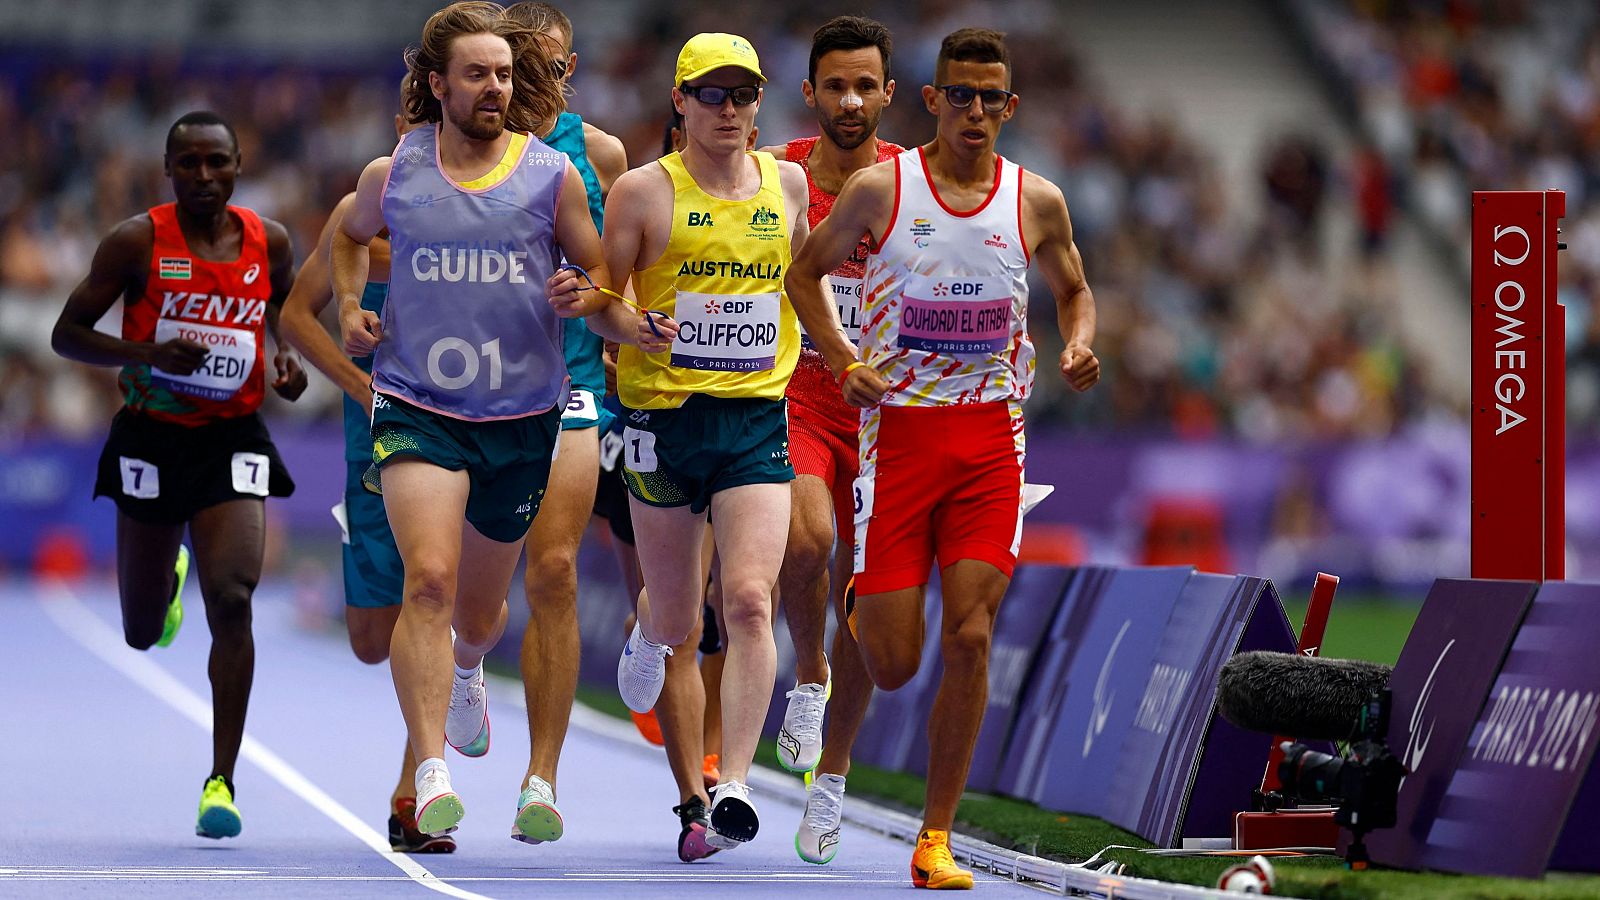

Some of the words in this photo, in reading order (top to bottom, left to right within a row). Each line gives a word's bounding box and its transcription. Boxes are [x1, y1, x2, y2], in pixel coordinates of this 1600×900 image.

[528, 152, 560, 160] PARIS
[528, 158, 560, 166] 2024
[984, 239, 1008, 249] amura
[411, 247, 528, 284] GUIDE
[677, 260, 782, 279] AUSTRALIA
[160, 291, 266, 325] KENYA
[903, 306, 958, 332] OUHDADI
[960, 310, 974, 332] EL
[976, 305, 1009, 333] ATABY
[178, 328, 237, 347] TOYOTA
[677, 320, 777, 347] CLIFFORD
[937, 343, 965, 351] PARIS
[968, 343, 991, 351] 2024
[1494, 280, 1527, 436] OMEGA
[198, 354, 246, 380] KEDI
[709, 361, 736, 369] PARIS
[739, 361, 760, 369] 2024
[631, 438, 641, 464] 1
[129, 466, 144, 490] 7
[245, 461, 259, 484] 7
[514, 502, 531, 514] AUS
[1472, 685, 1551, 766] PARIS
